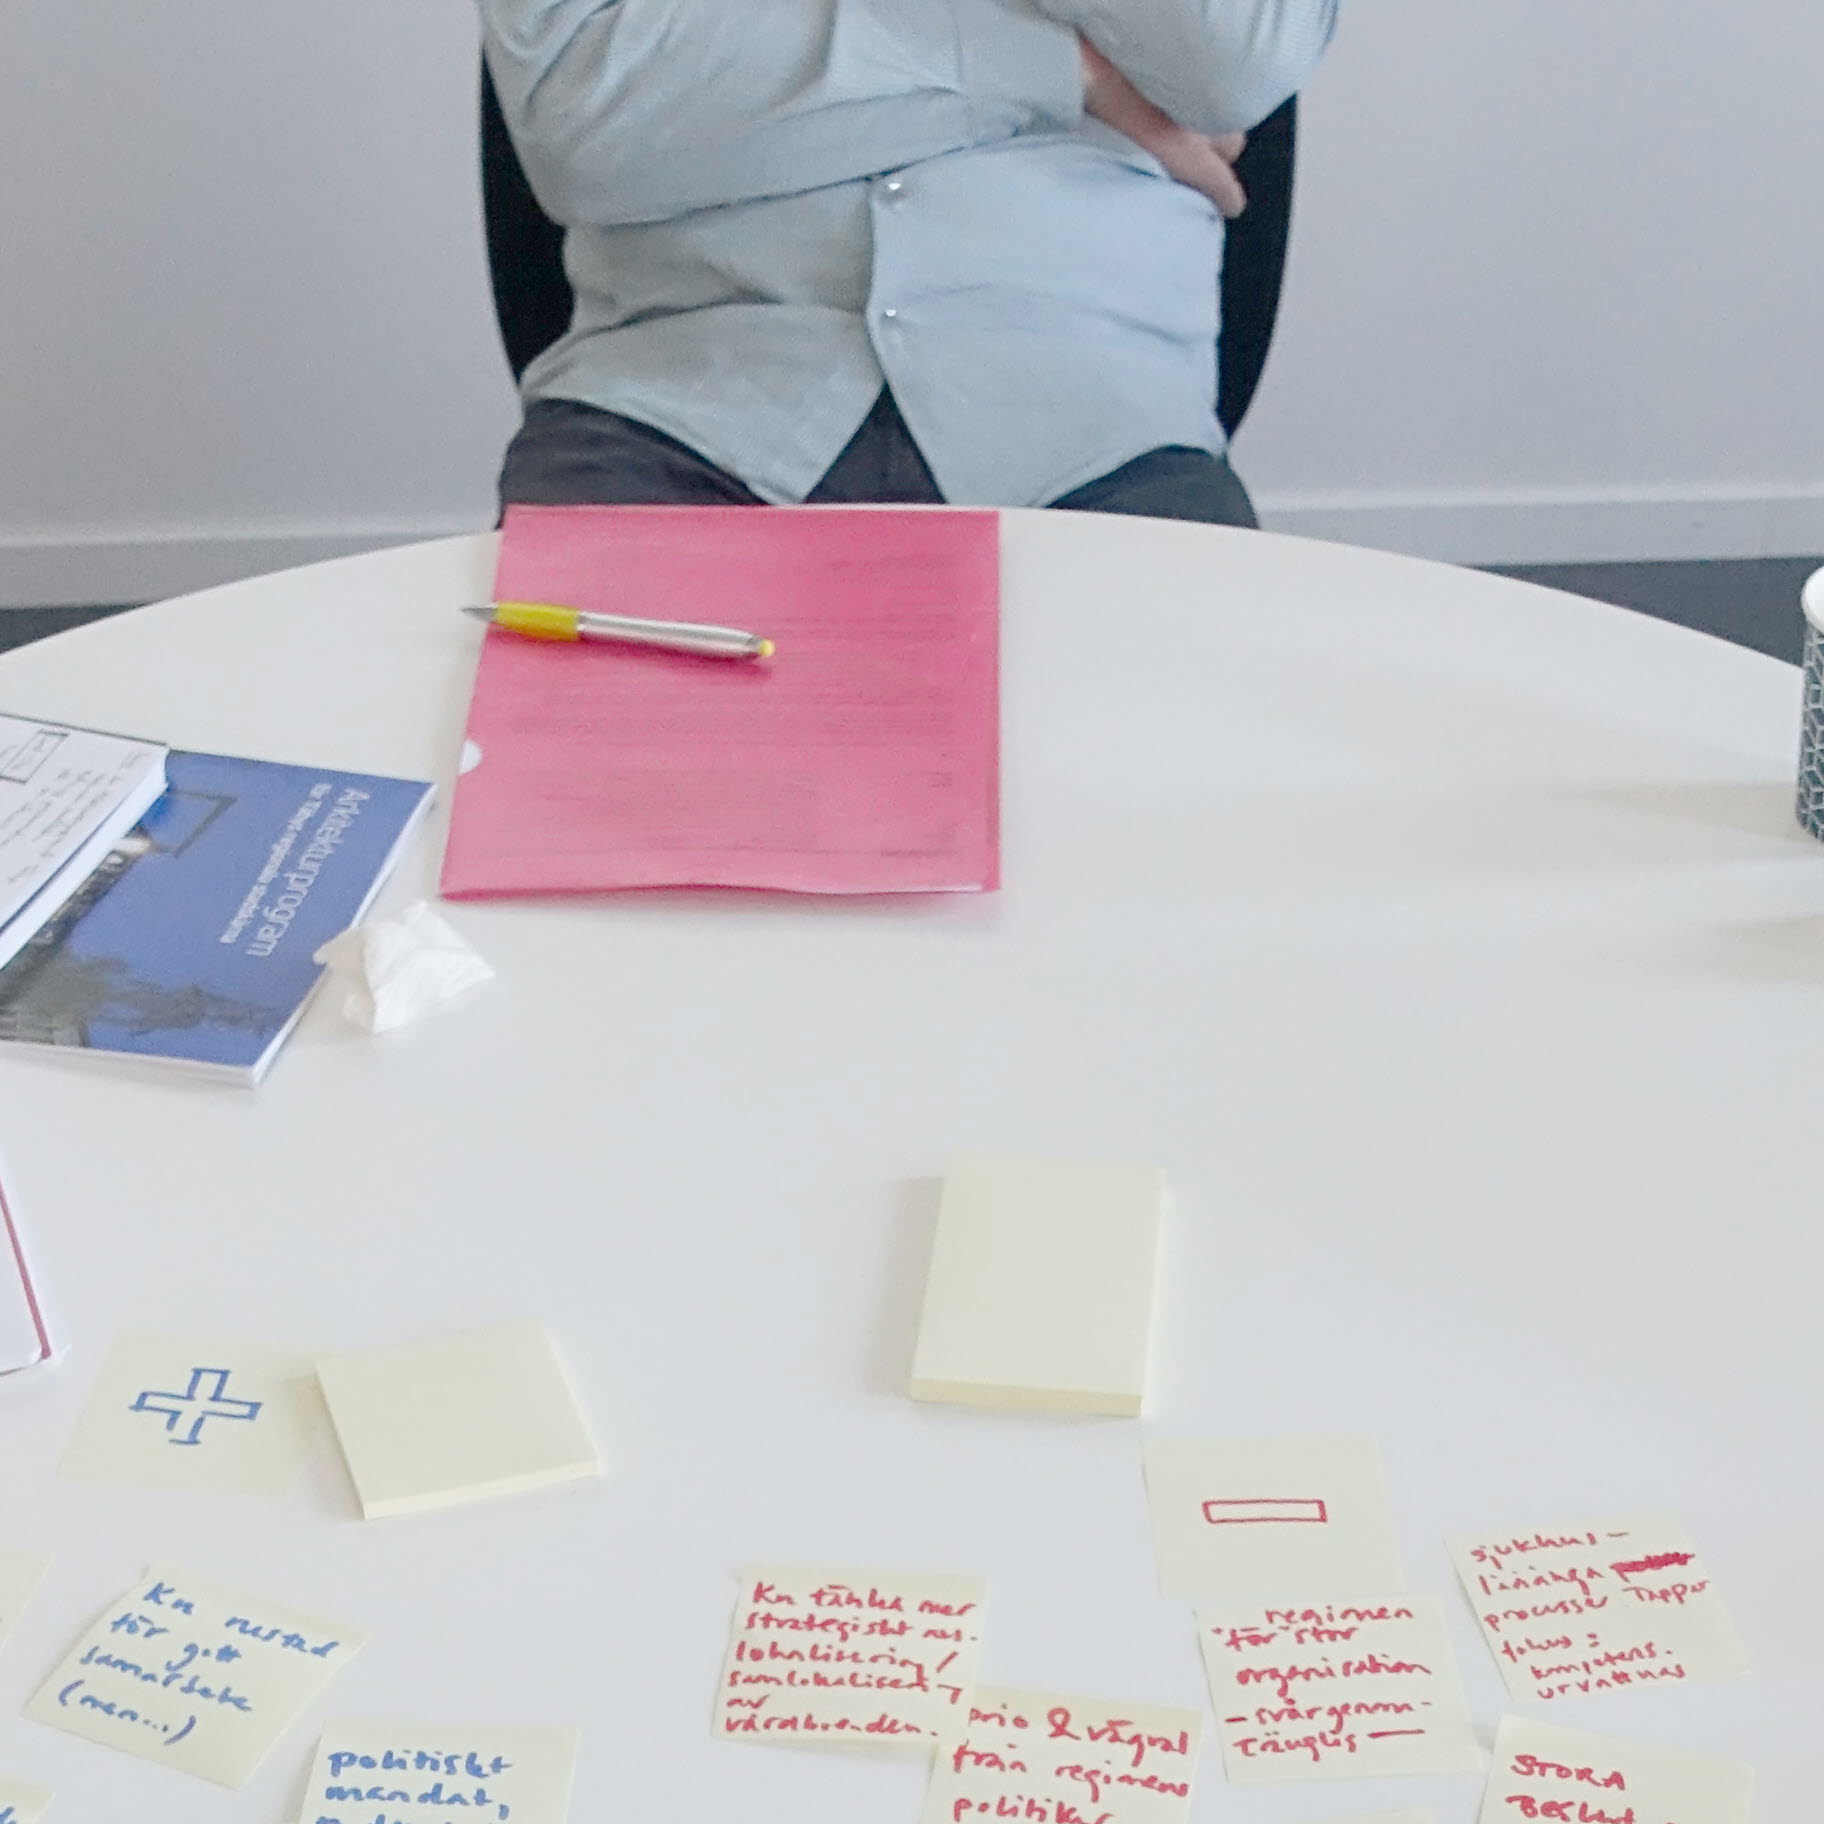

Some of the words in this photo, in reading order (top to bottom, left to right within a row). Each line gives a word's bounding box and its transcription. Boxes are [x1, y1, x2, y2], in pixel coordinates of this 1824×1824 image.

[245, 787, 371, 957] Arkitekturprogram
[809, 1583, 904, 1613] tänka
[917, 1599, 977, 1617] mer
[745, 1611, 914, 1643] strategiskt
[1236, 1653, 1433, 1698] organisation
[726, 1694, 771, 1710] av
[328, 1749, 514, 1779] politiskt
[952, 1738, 1028, 1773] från
[1509, 1754, 1627, 1792] STORA
